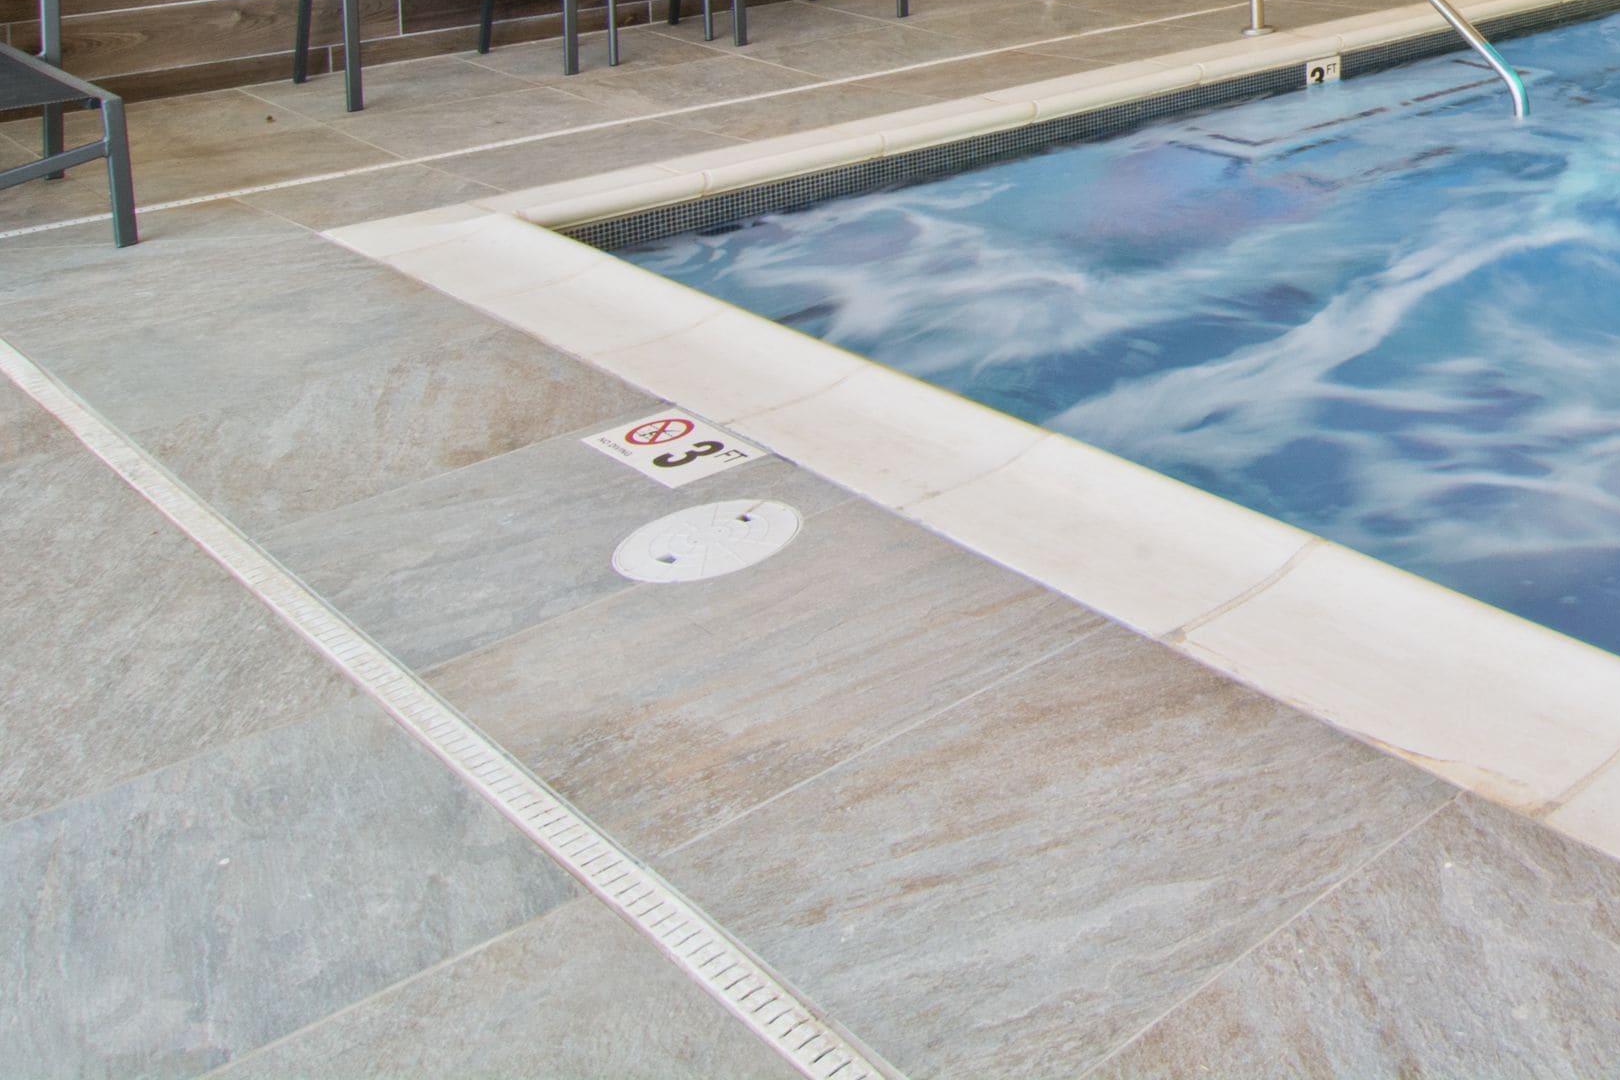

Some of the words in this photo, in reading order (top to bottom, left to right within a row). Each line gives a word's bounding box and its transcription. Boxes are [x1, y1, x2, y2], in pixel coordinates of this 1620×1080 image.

[1326, 63, 1337, 75] FT
[652, 441, 725, 468] 3
[714, 449, 748, 462] FT
